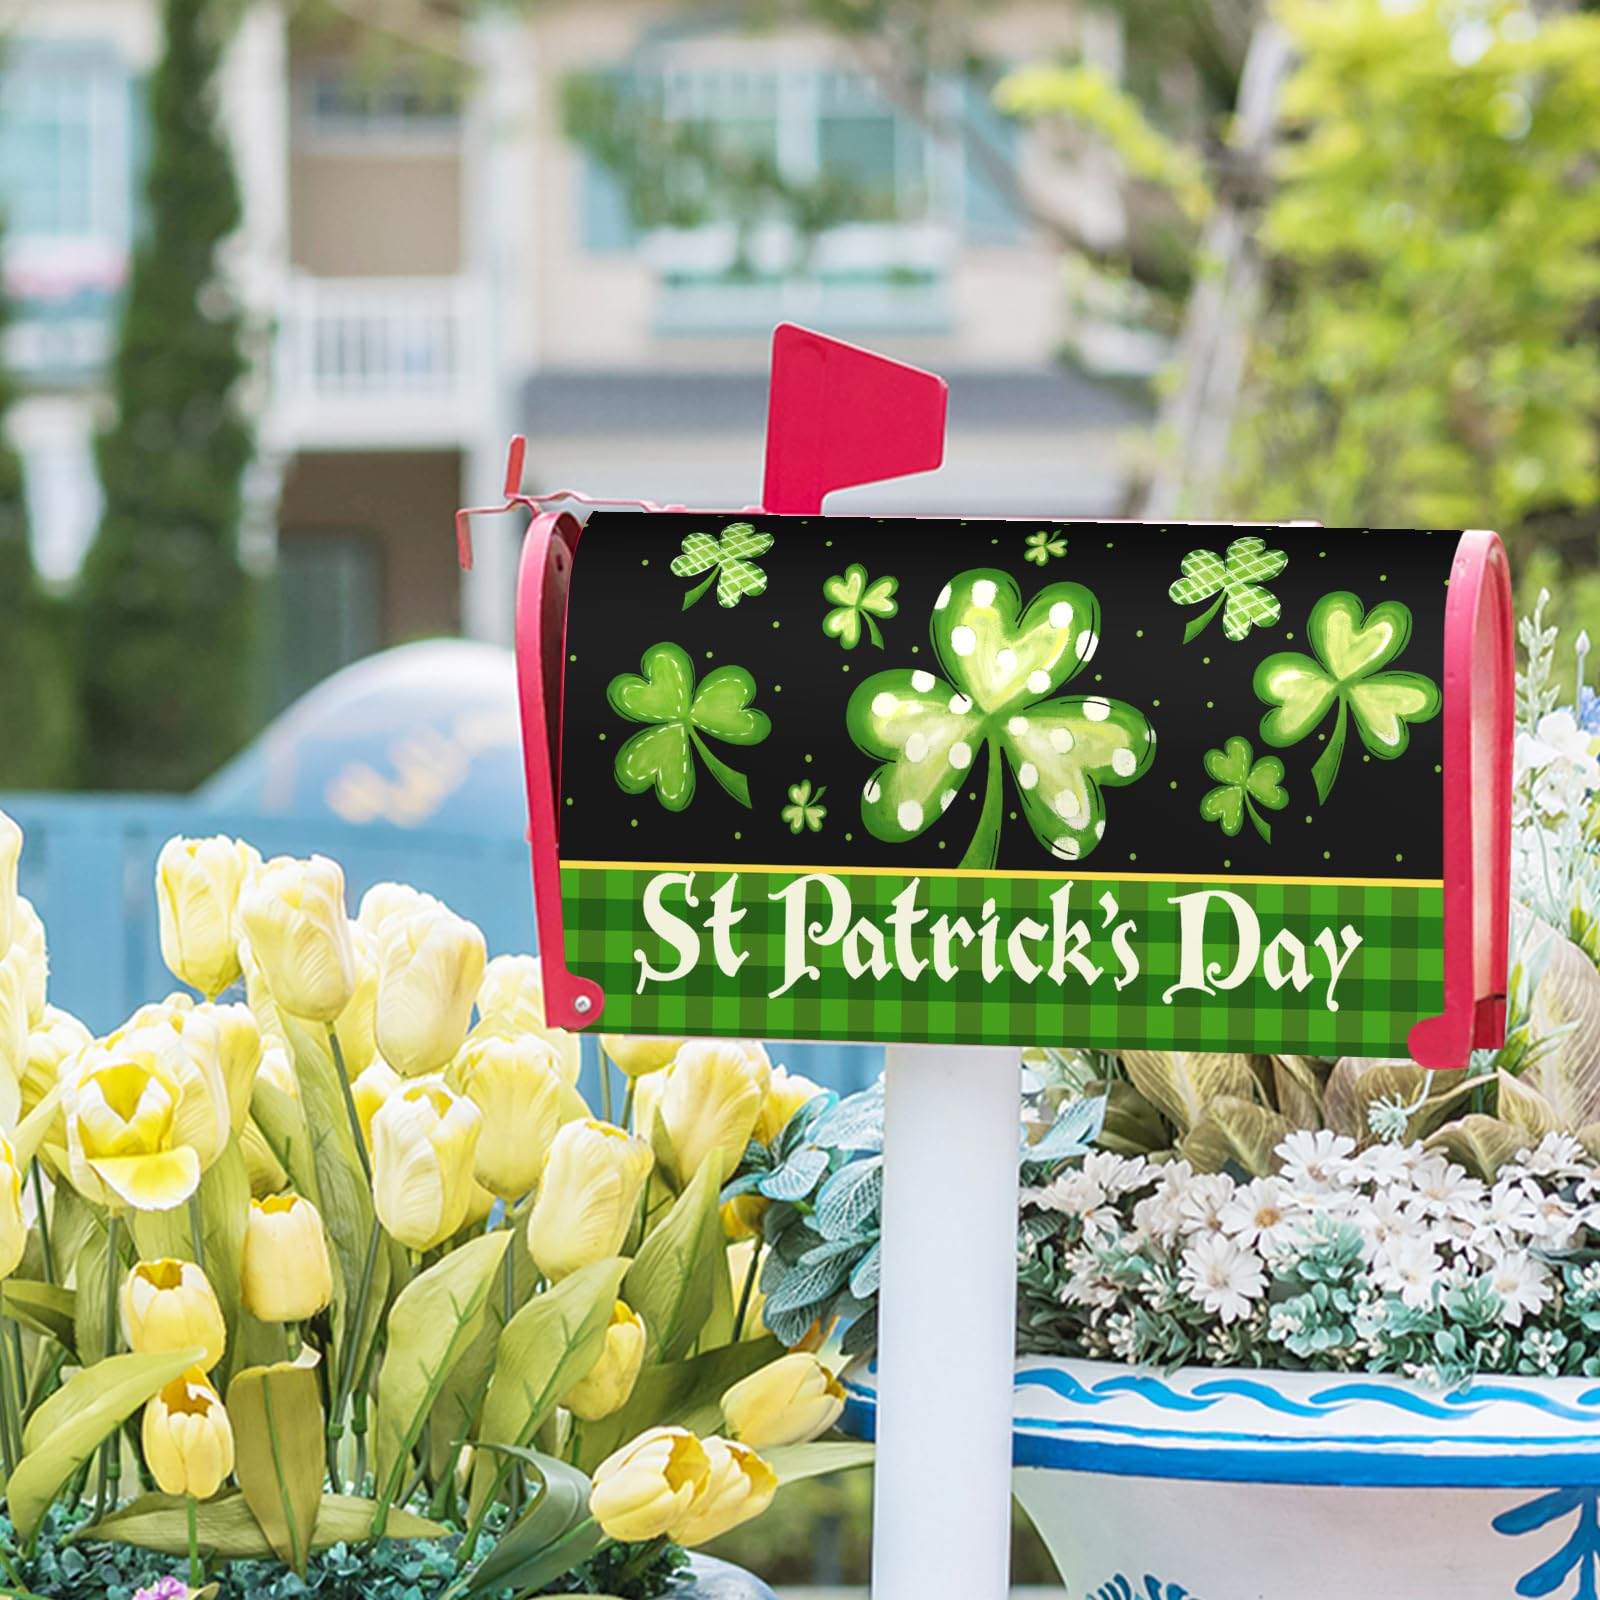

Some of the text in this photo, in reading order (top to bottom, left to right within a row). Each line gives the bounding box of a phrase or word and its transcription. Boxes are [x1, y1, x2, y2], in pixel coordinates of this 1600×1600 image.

[633, 871, 1363, 1012] St Patrick's Day
